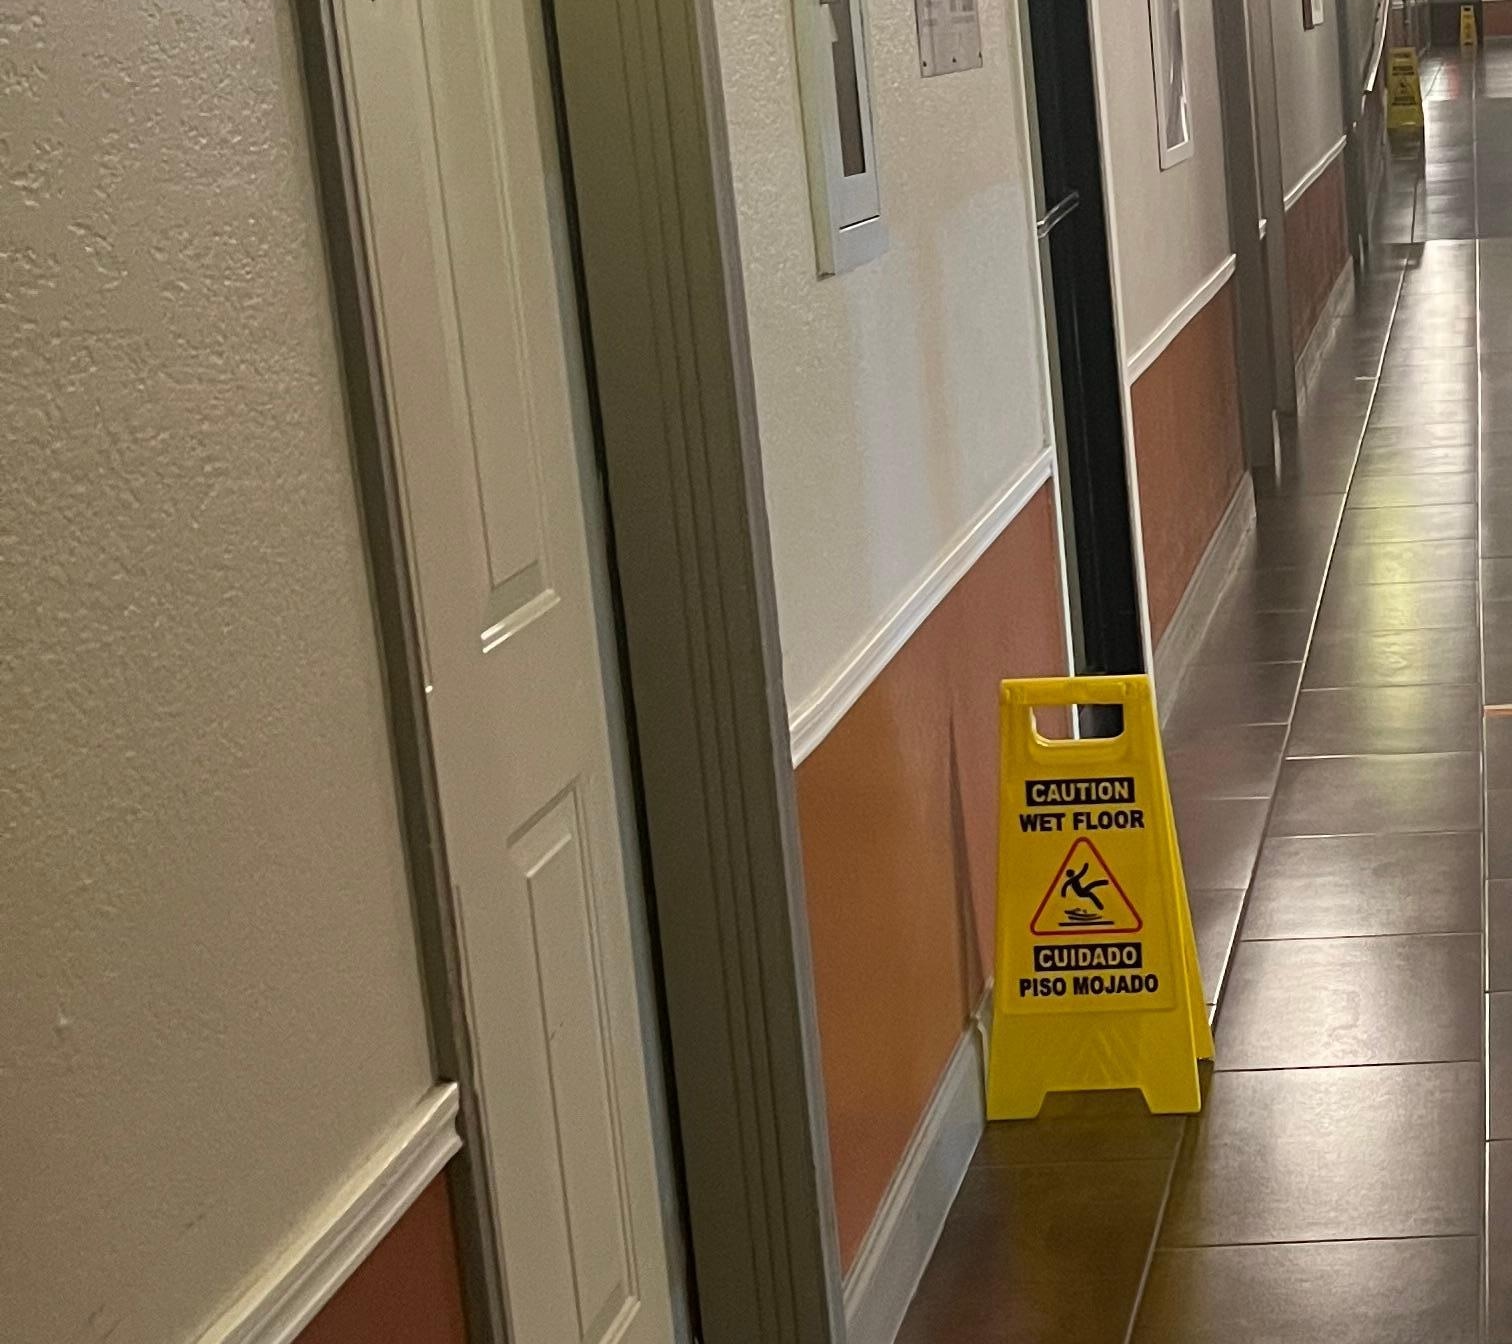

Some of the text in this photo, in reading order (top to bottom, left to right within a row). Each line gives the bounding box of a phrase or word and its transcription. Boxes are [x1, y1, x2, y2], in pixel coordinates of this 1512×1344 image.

[1031, 781, 1129, 803] CAUTION
[1019, 810, 1145, 832] WET FLOOR
[1038, 947, 1137, 968] CUIDADO
[1019, 974, 1158, 997] PISO MOJADO
